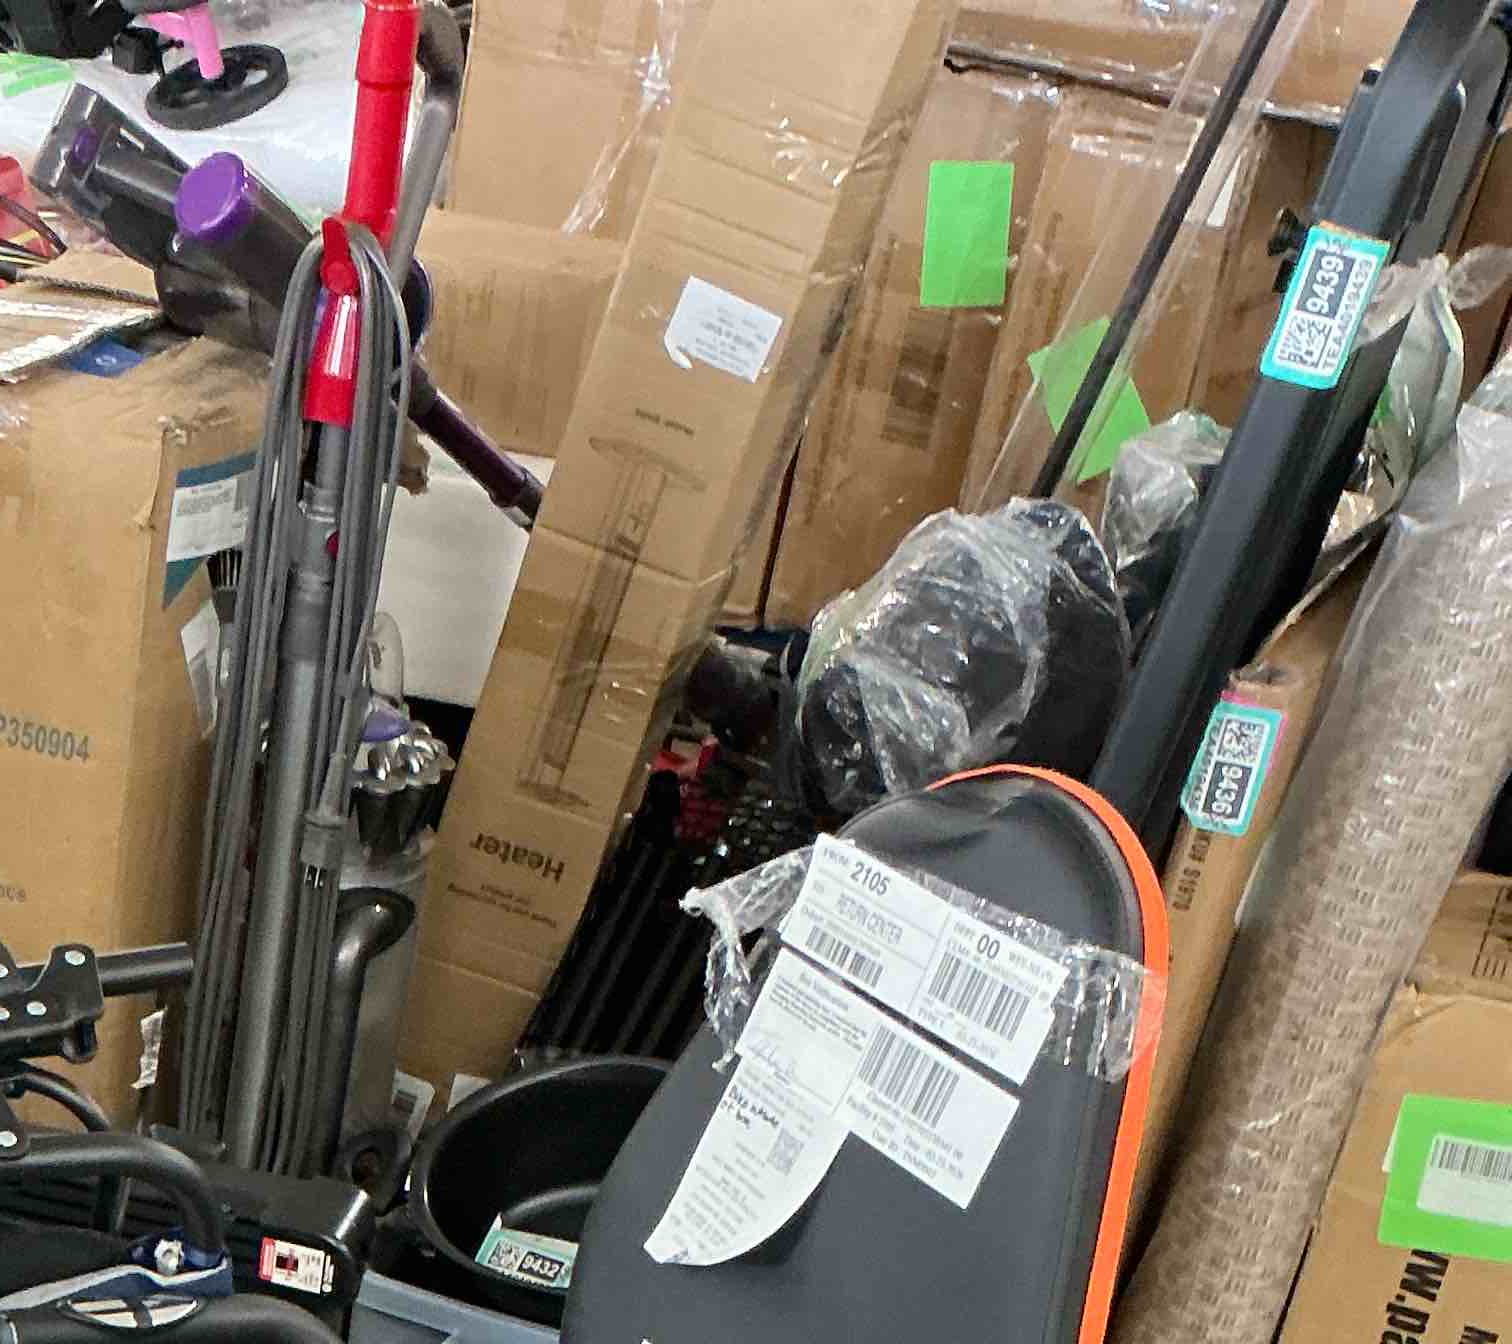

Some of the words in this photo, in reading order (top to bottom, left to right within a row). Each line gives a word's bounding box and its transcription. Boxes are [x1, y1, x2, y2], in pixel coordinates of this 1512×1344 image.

[1305, 255, 1345, 314] 9439
[1211, 764, 1243, 815] 9436
[469, 833, 565, 883] Heater
[850, 862, 890, 897] 2105
[976, 934, 1001, 960] 00
